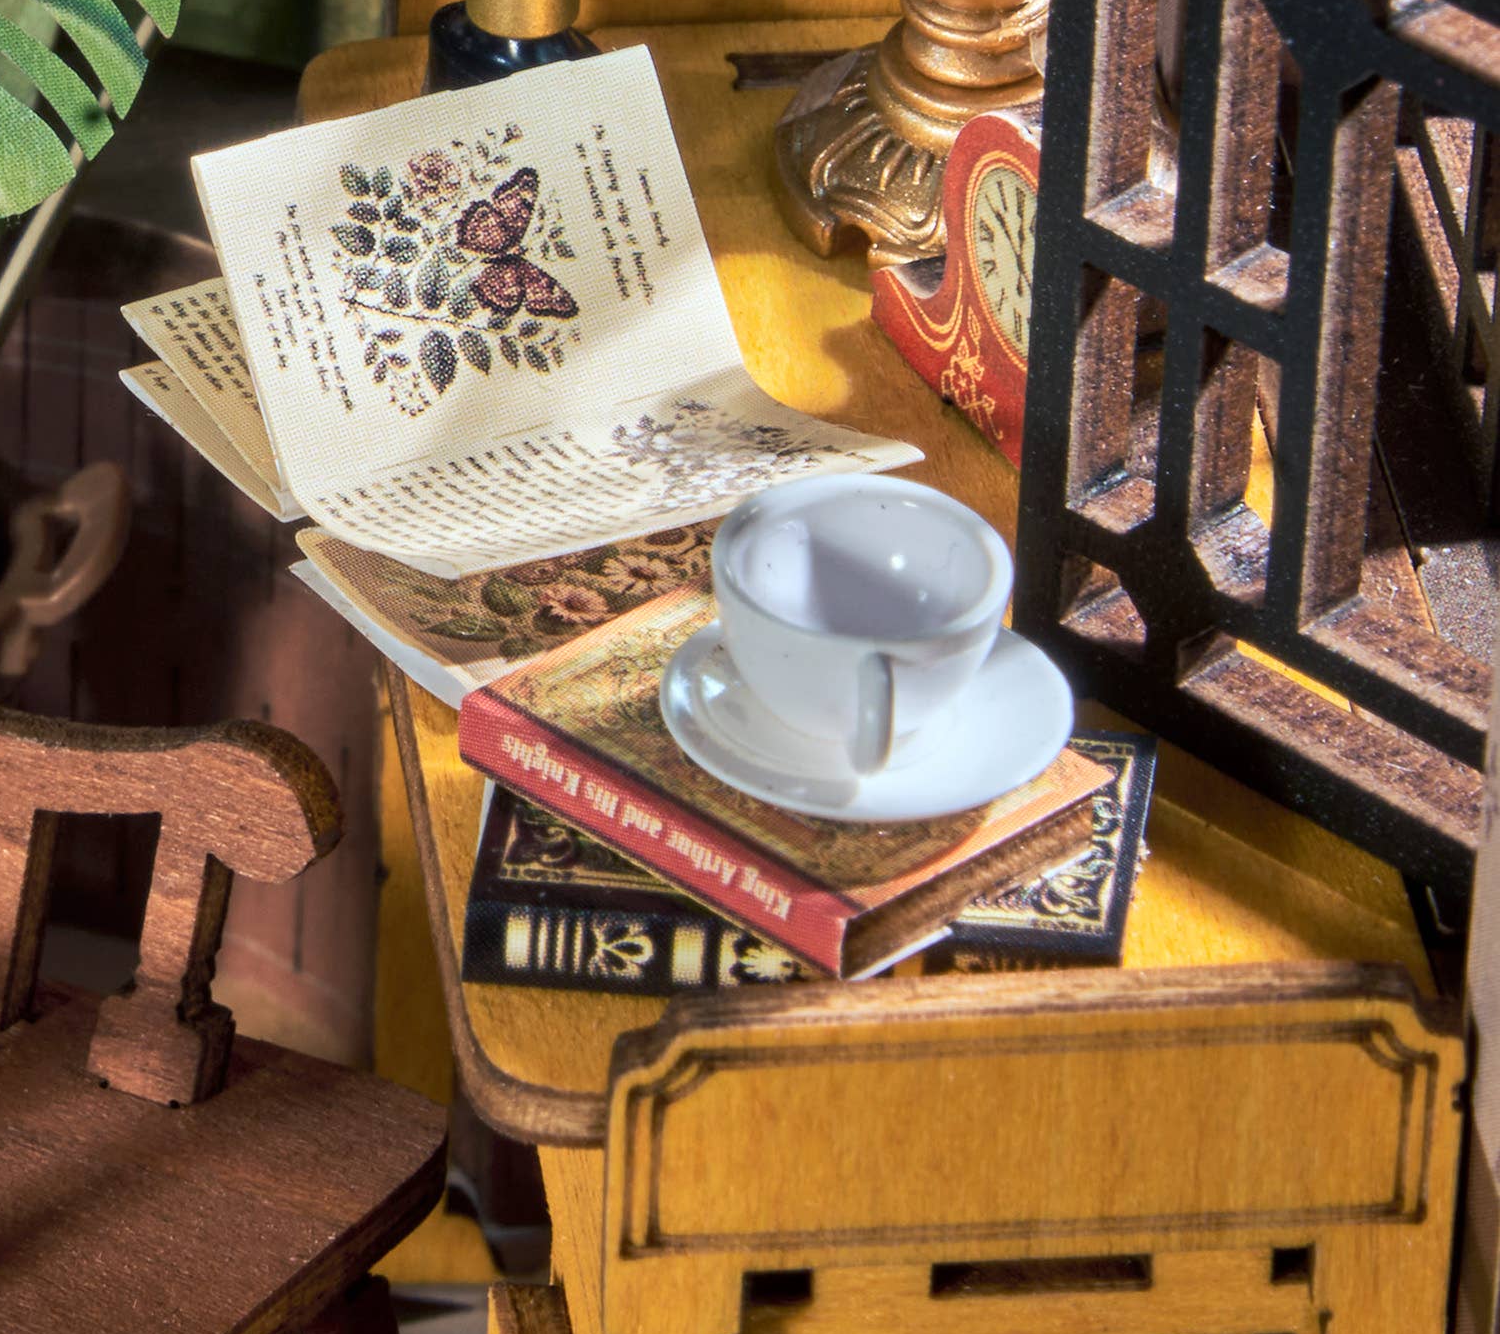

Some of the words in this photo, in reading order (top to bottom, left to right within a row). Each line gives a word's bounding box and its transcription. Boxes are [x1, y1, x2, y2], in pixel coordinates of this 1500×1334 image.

[501, 734, 581, 797] Knights
[584, 781, 620, 818] His
[622, 803, 663, 839] and
[666, 829, 737, 885] Arthur
[740, 866, 792, 920] King
